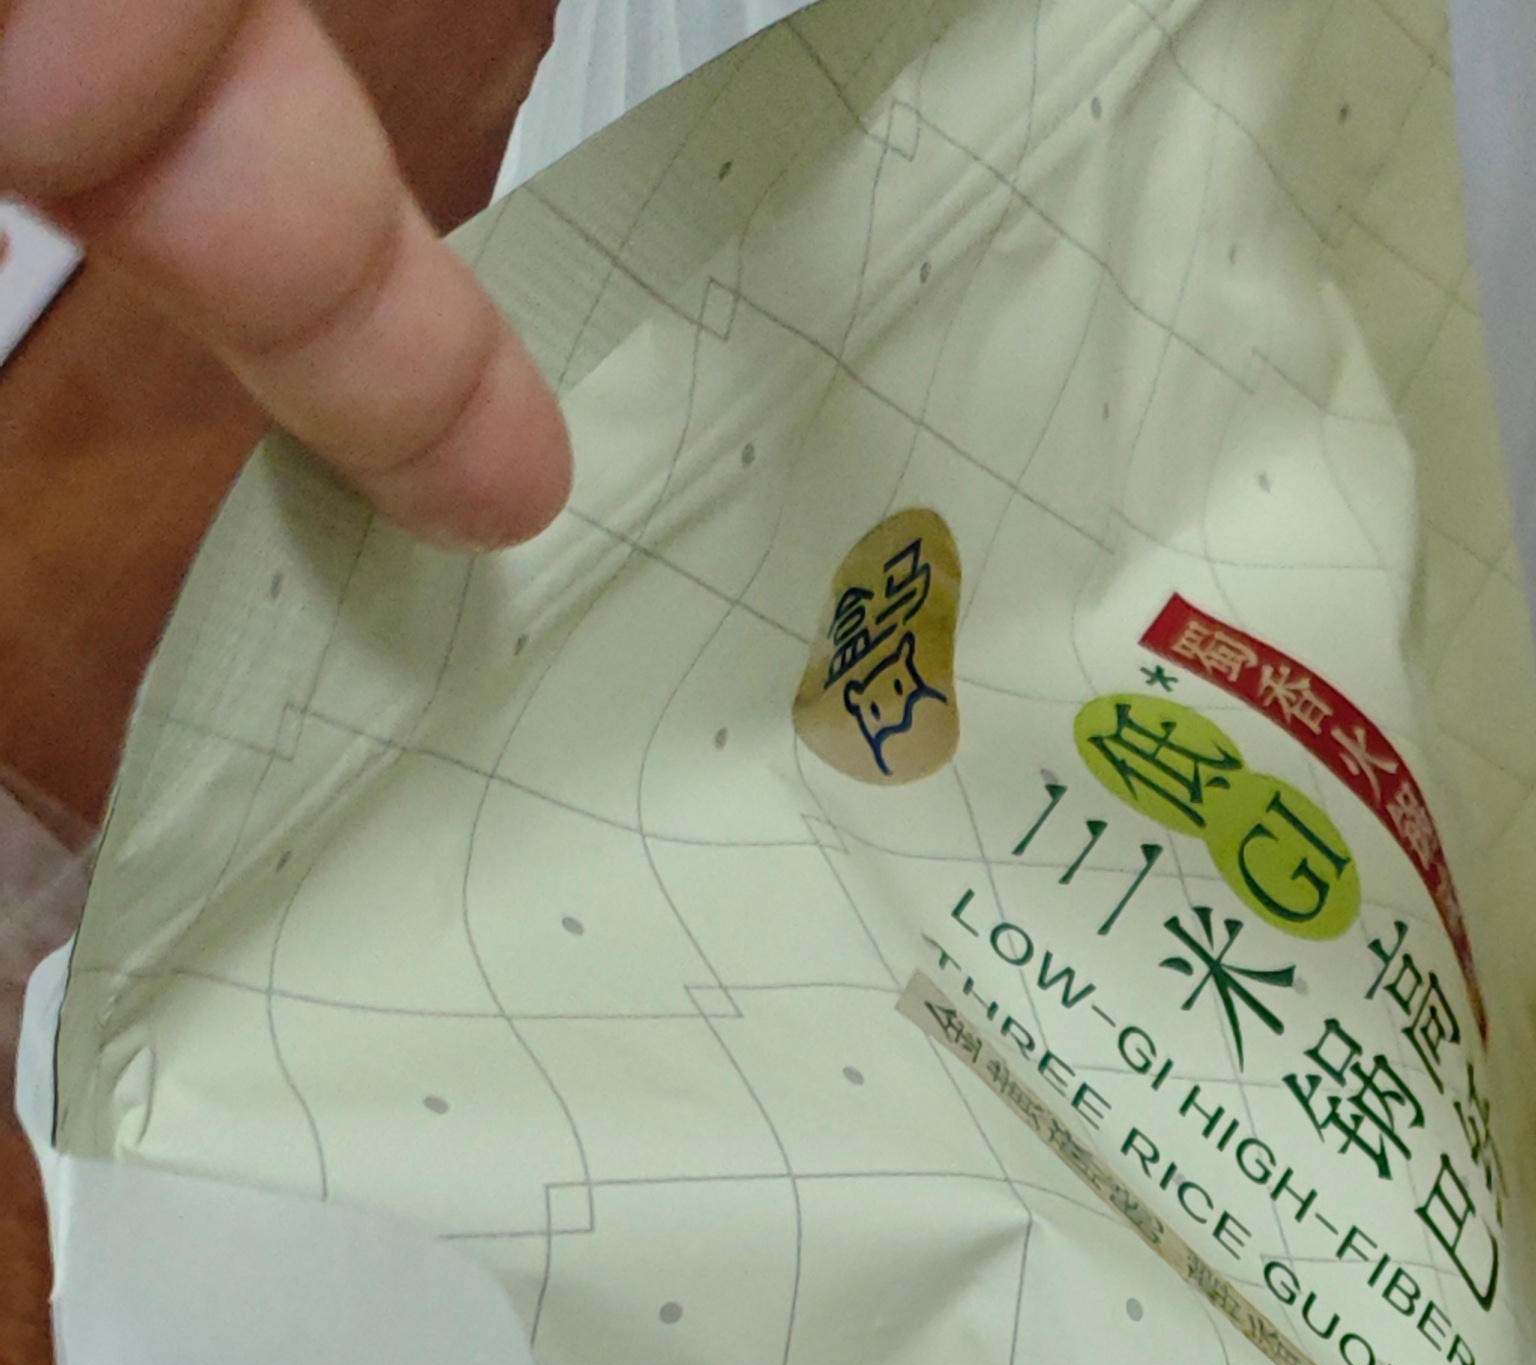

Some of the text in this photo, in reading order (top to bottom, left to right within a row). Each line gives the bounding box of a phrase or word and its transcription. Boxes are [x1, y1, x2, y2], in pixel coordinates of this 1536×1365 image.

[824, 537, 931, 690] 盒马
[922, 933, 1113, 1131] THREE
[1119, 1126, 1252, 1260] RICE
[950, 887, 1175, 1092] LOW-GI
[1012, 783, 1498, 1312] 三米锅巴
